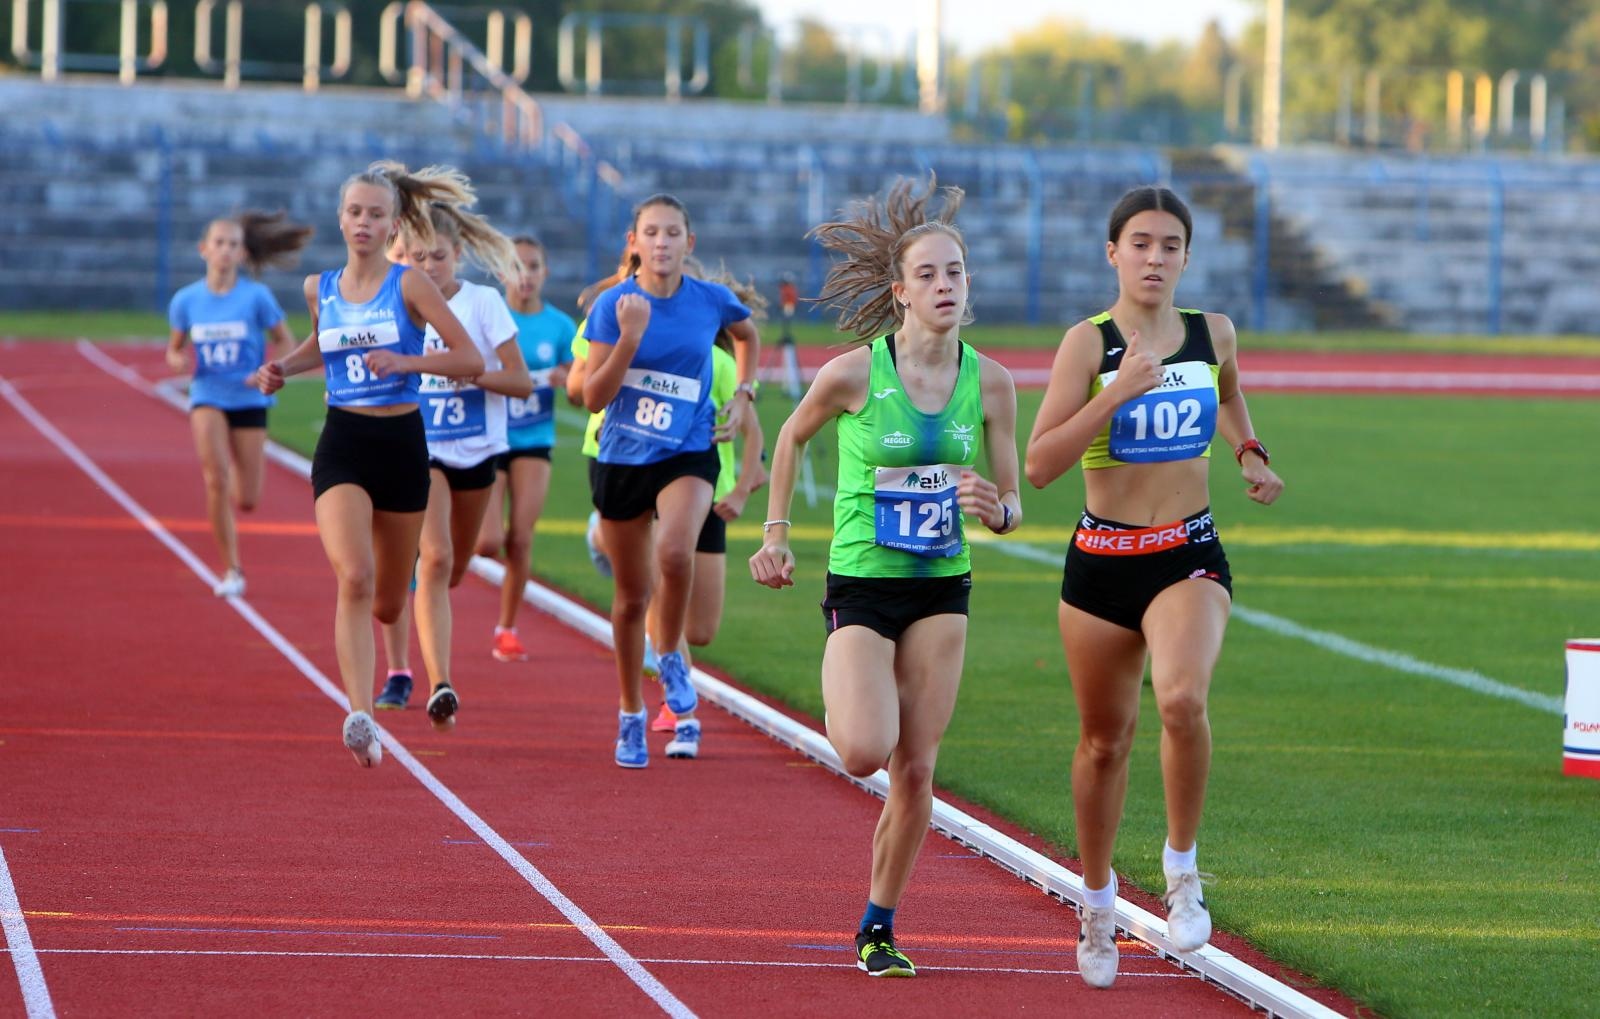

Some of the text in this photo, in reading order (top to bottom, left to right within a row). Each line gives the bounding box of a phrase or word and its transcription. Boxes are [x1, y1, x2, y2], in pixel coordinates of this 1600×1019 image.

[349, 332, 378, 346] akk
[201, 343, 240, 366] 147
[651, 380, 679, 394] akk
[1161, 372, 1187, 387] kk
[428, 397, 465, 426] 73
[635, 397, 673, 430] 86
[1129, 399, 1202, 440] 102
[920, 470, 948, 489] akk
[893, 498, 953, 538] 125
[1077, 533, 1135, 550] NIKE
